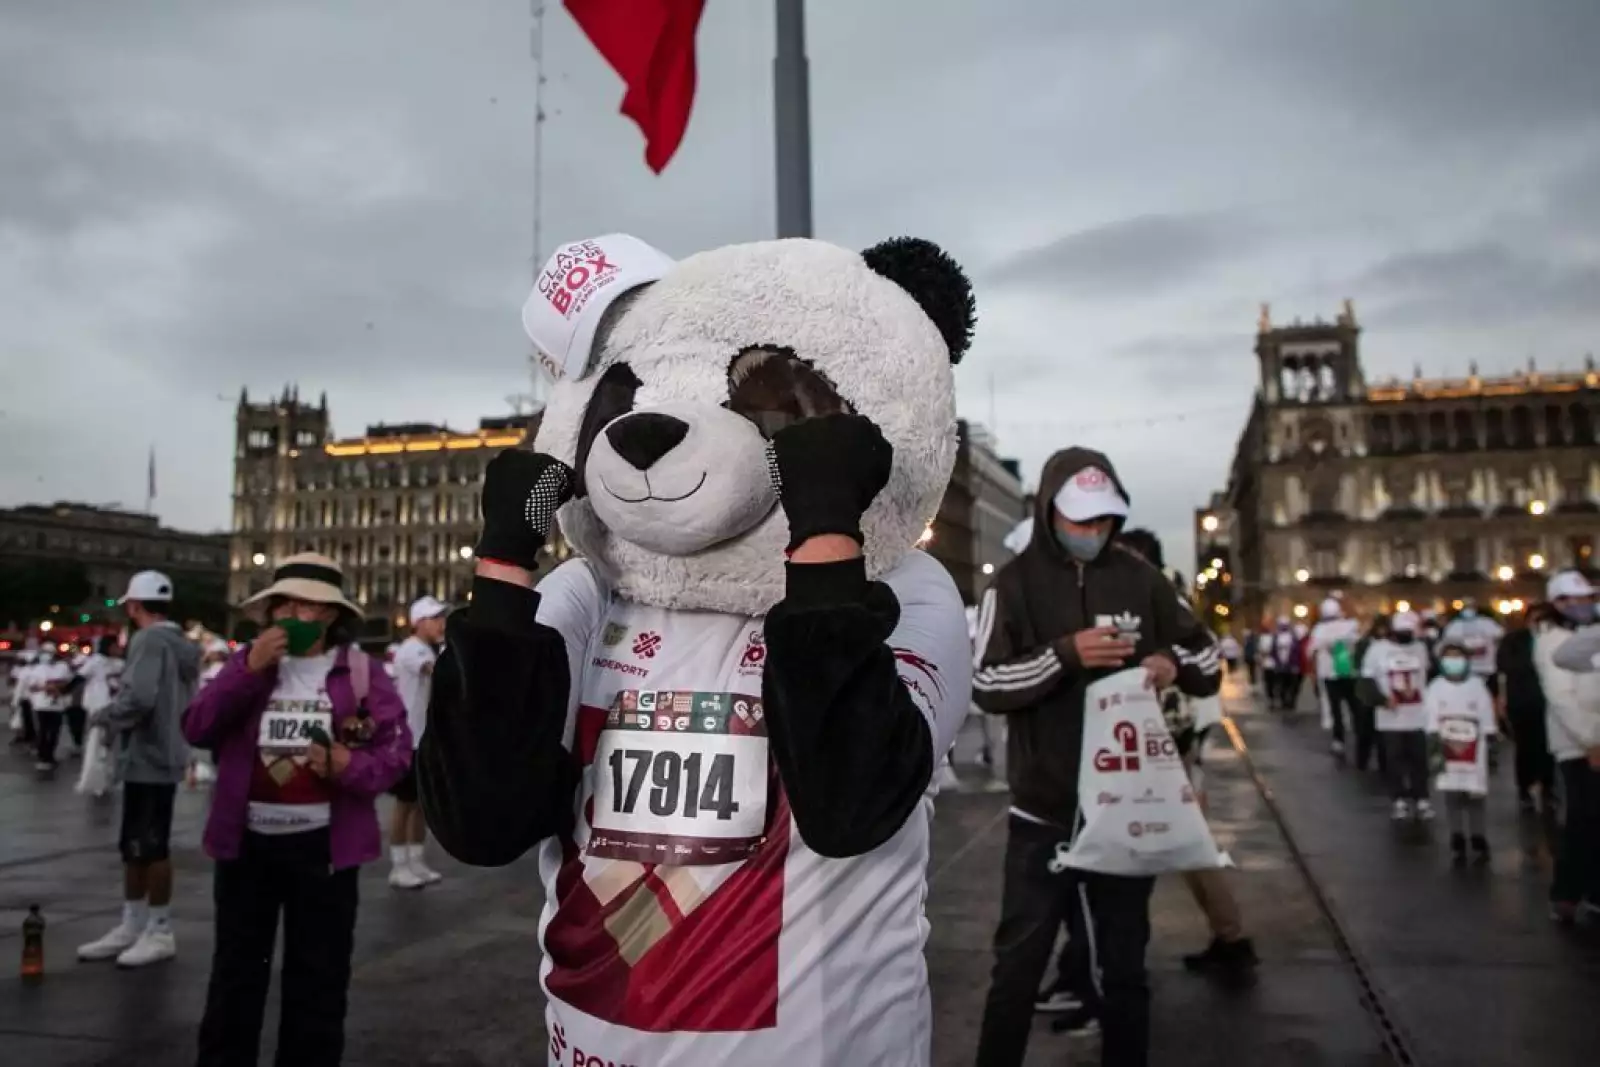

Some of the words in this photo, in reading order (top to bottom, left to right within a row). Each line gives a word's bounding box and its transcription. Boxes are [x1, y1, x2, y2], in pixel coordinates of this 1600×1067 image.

[538, 240, 597, 293] CLASE
[552, 255, 617, 315] BOX
[592, 658, 649, 678] INDEPORTE
[609, 749, 740, 820] 17914
